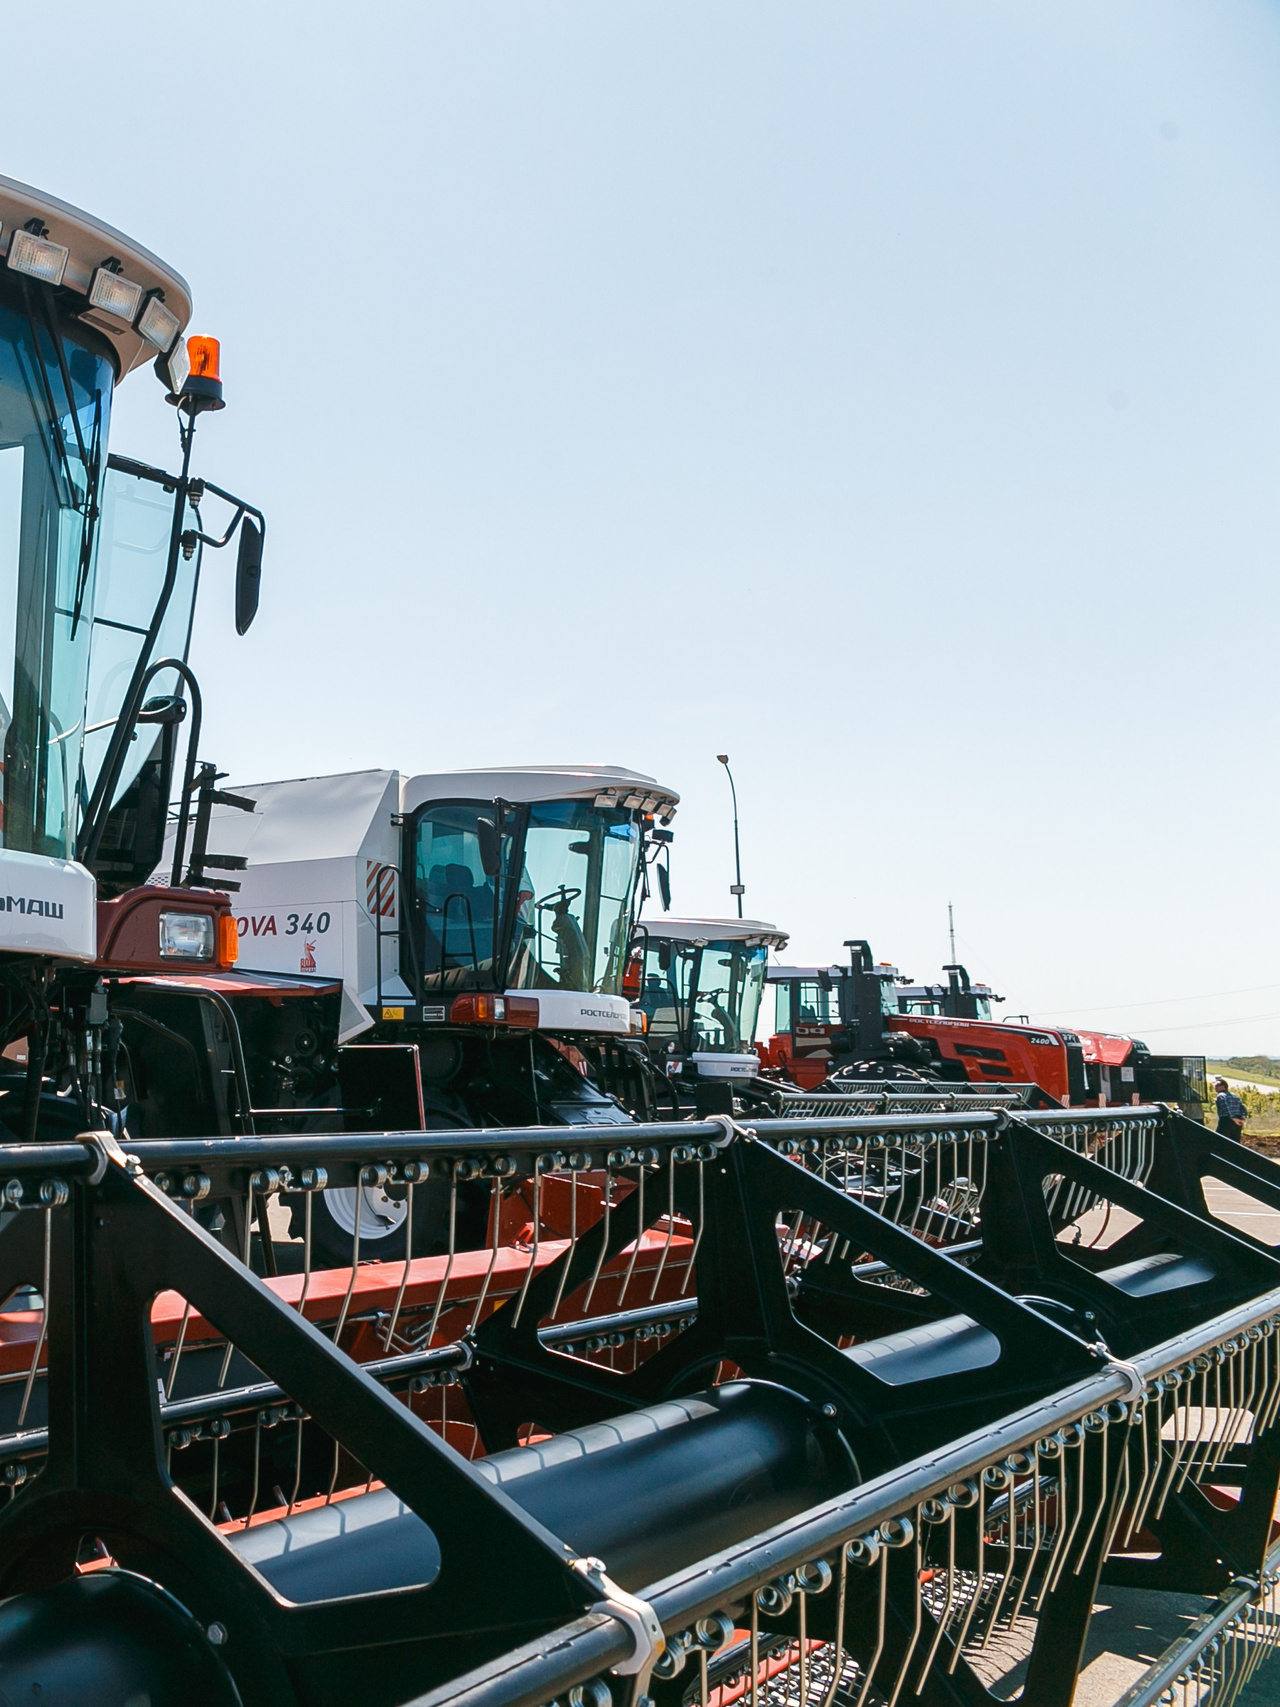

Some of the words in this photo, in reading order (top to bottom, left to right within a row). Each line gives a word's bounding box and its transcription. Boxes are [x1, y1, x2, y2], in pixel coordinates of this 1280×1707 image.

[238, 915, 277, 937] OVA
[285, 911, 331, 935] 340
[580, 1009, 627, 1020] РОСТСЕЛЬ
